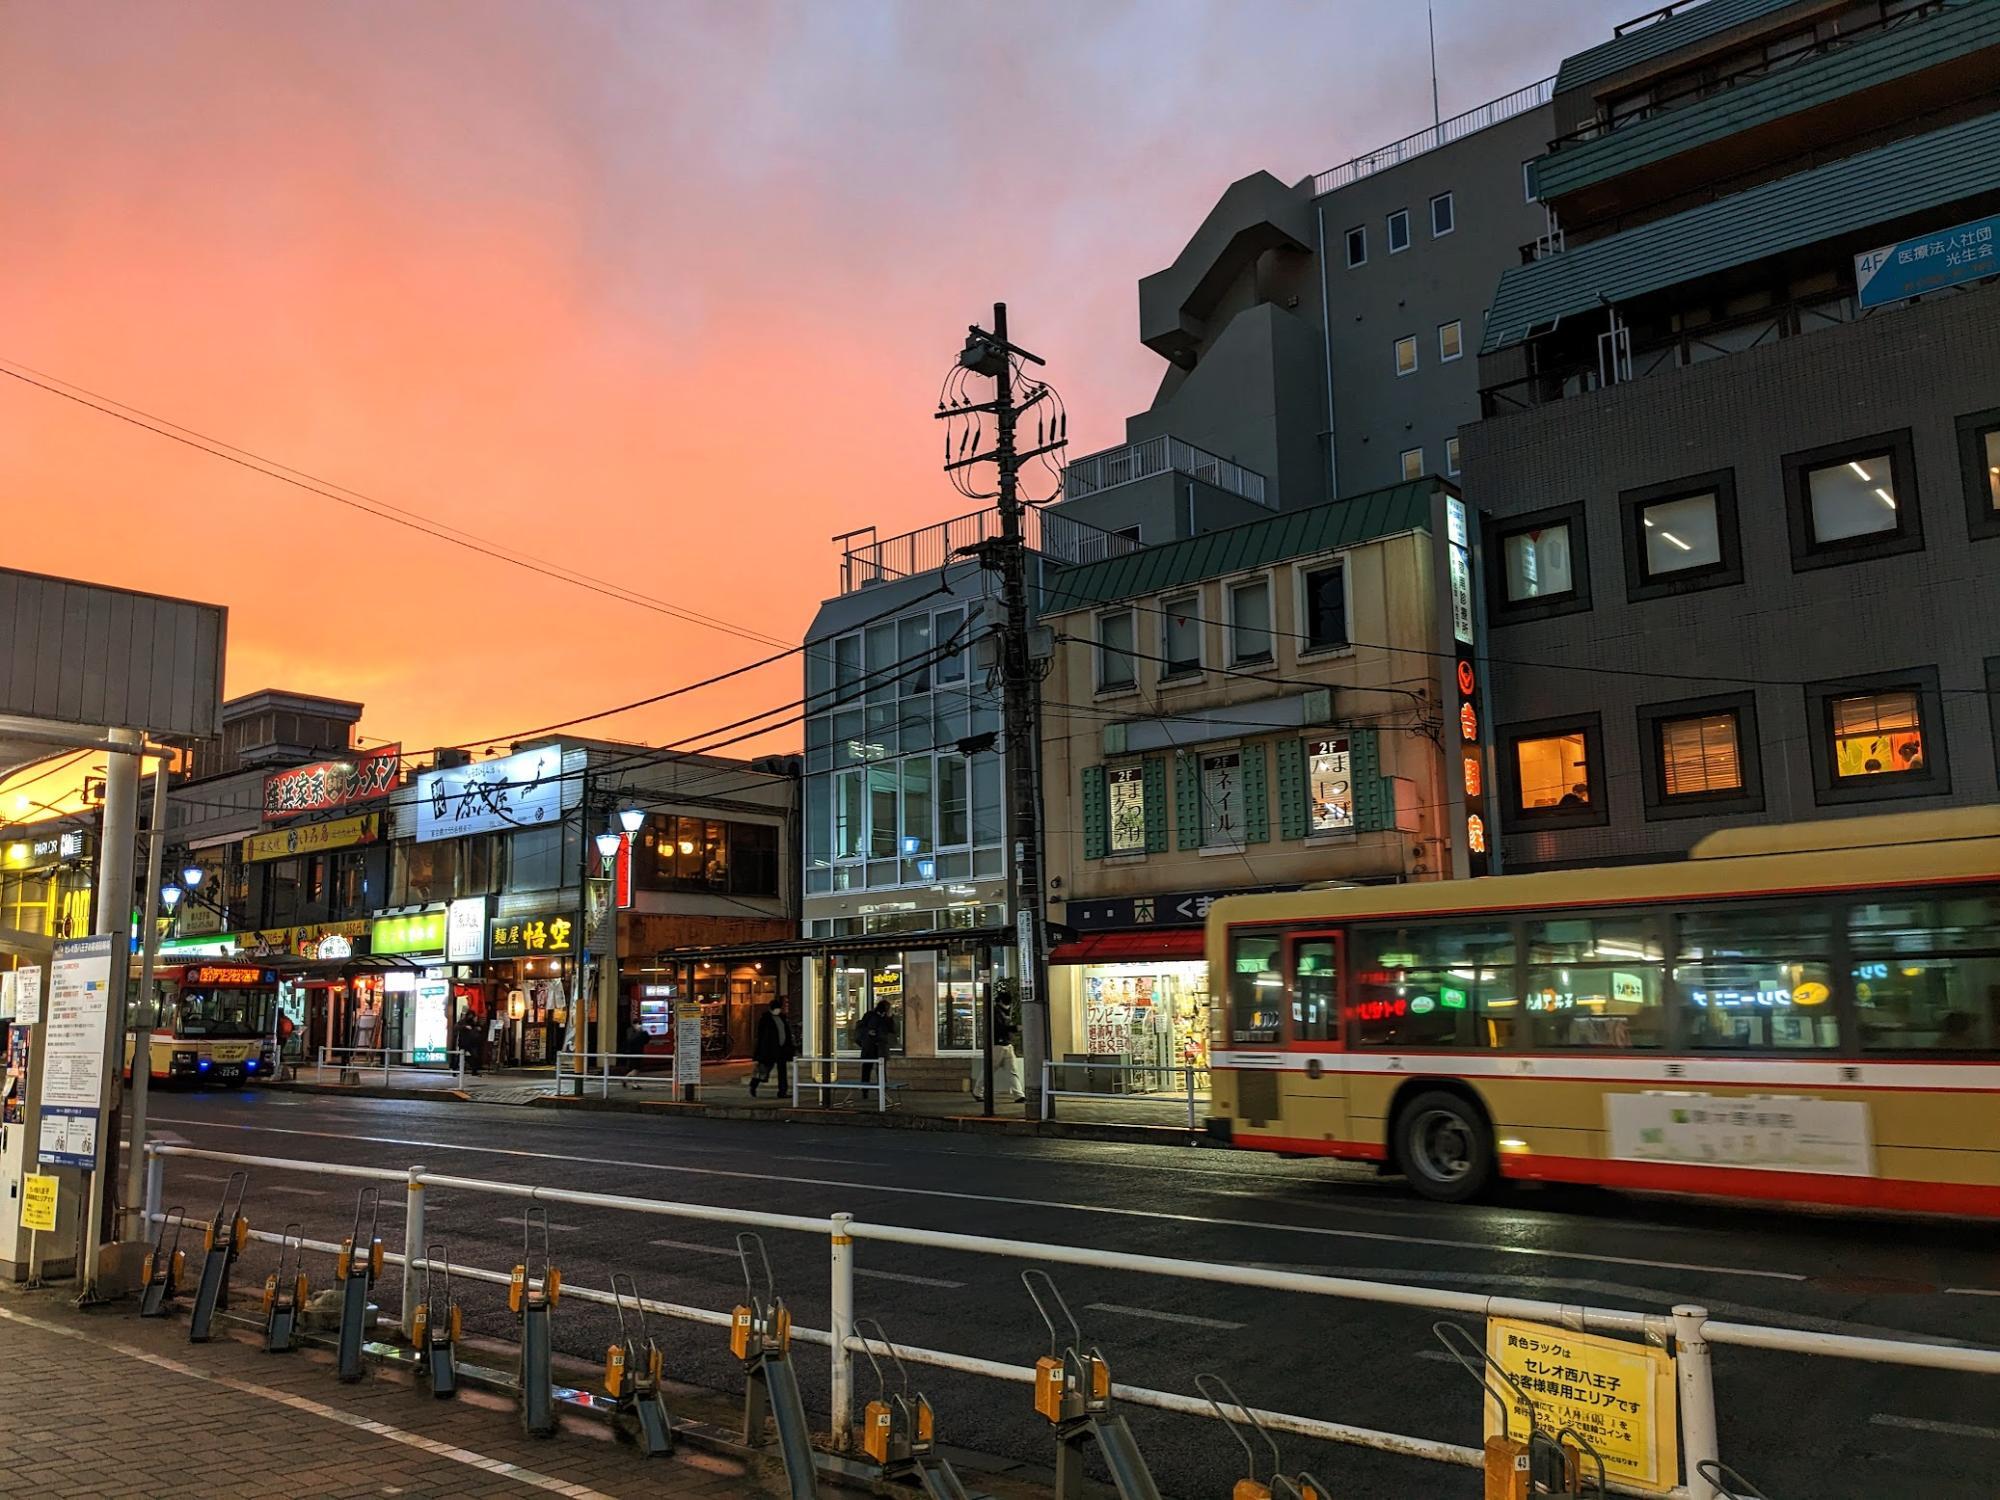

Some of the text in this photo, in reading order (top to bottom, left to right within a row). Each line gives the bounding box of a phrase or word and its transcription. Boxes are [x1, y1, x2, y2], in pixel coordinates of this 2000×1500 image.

[1898, 226, 1992, 265] 医療法人社団
[1945, 243, 1993, 268] 光生会
[1860, 251, 1884, 273] 4F
[1319, 741, 1337, 755] 2F
[1118, 770, 1133, 783] 2F
[1215, 770, 1234, 833] ネイル
[1113, 785, 1129, 844] エクステ
[34, 840, 58, 856] PARLOR
[523, 917, 572, 949] 悟空
[1508, 1334, 1572, 1359] 黄色ラックは
[1052, 1370, 1061, 1380] 41
[1524, 1358, 1621, 1391] セレオ西八王子
[1508, 1372, 1640, 1413] お客様専用エリアです
[1513, 1405, 1632, 1440] 発行うえ、レジで駐輪コインを
[1517, 1456, 1527, 1469] 43
